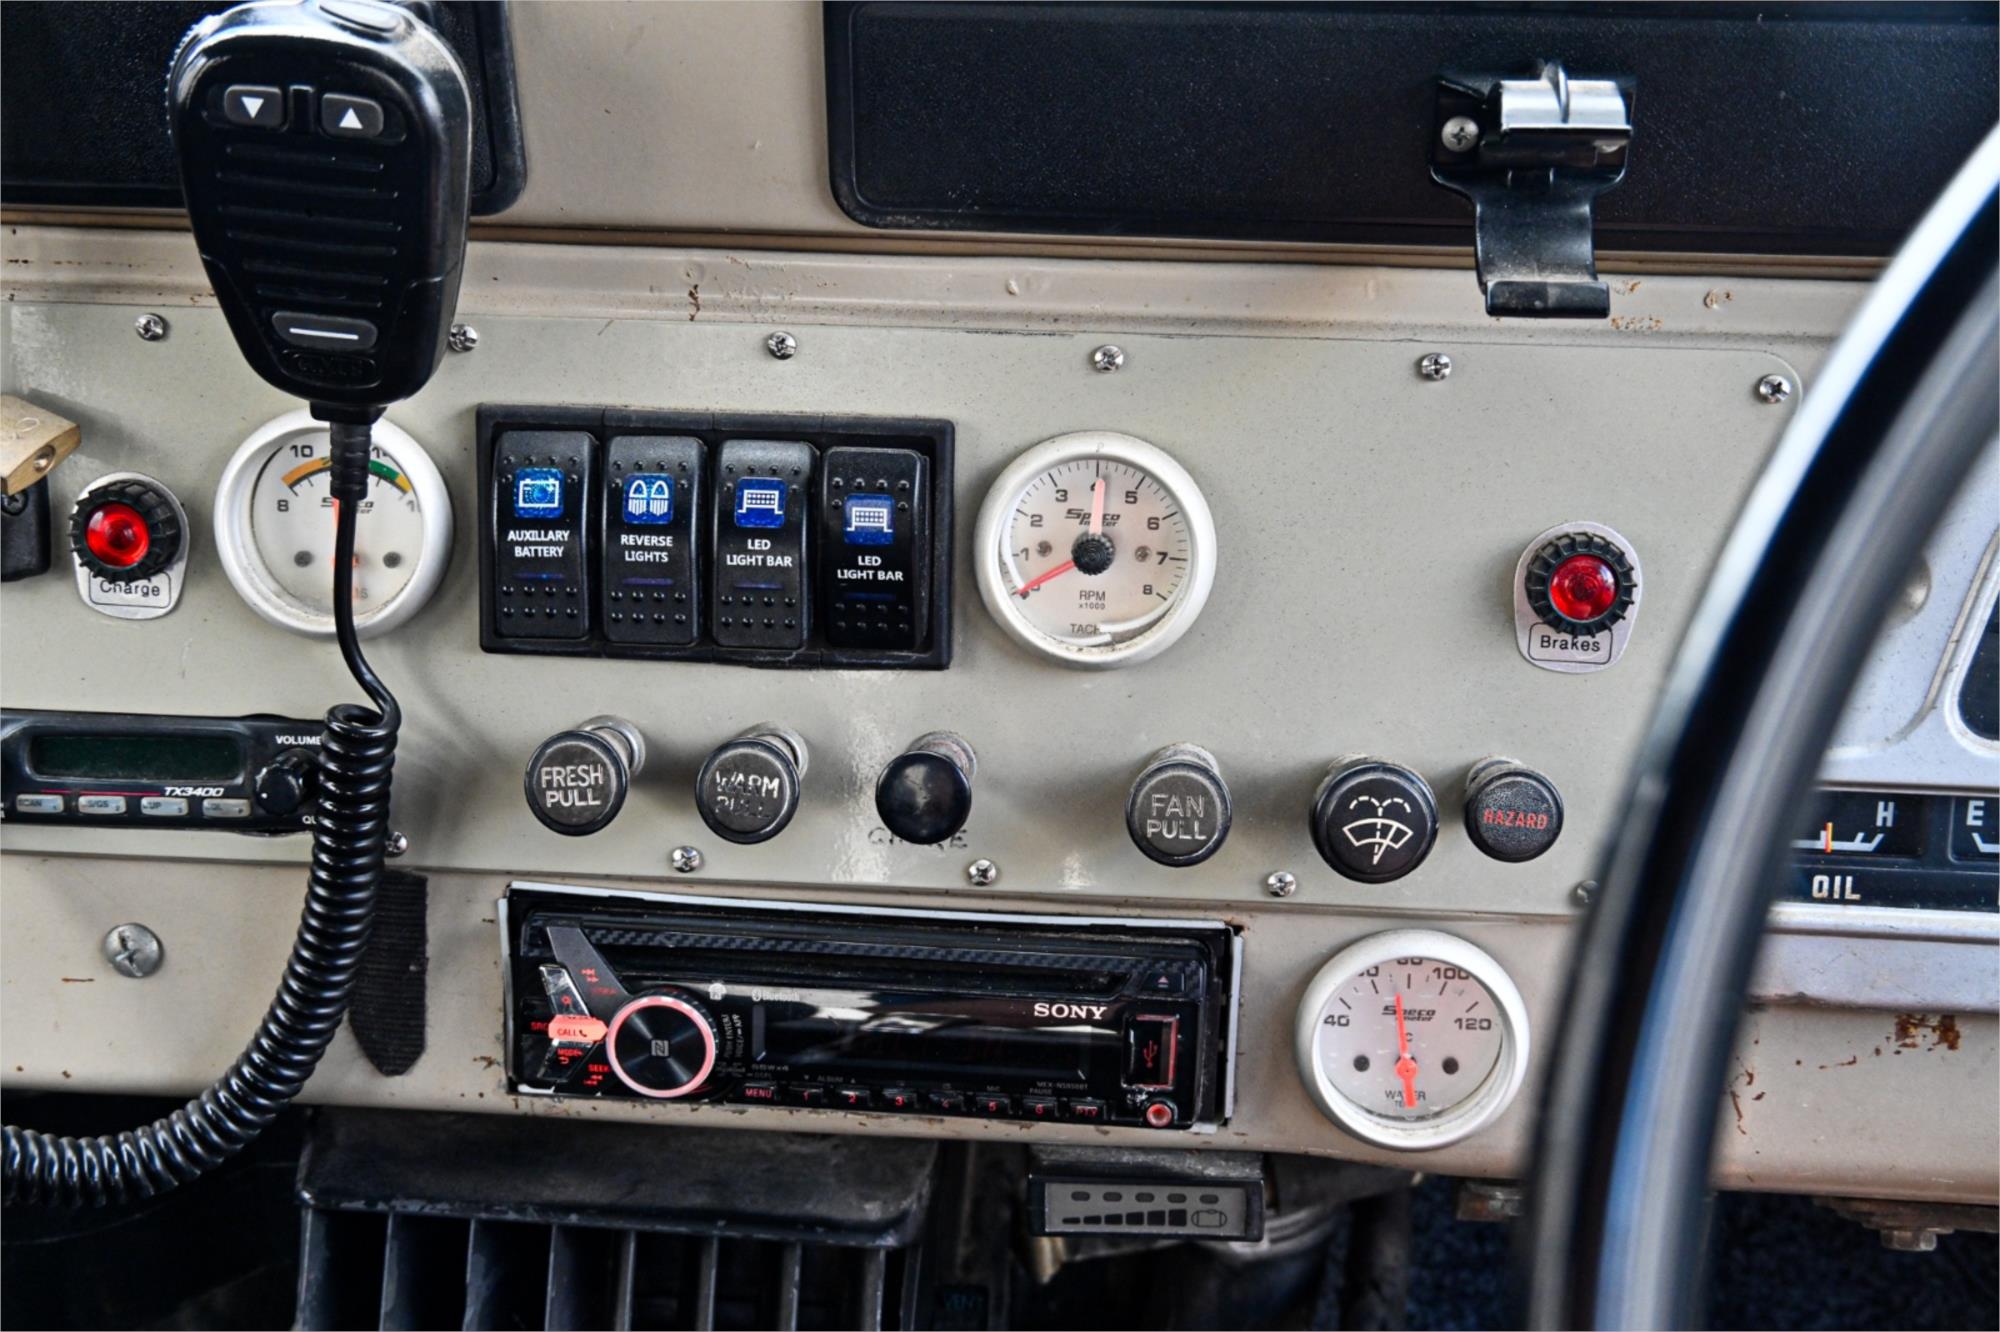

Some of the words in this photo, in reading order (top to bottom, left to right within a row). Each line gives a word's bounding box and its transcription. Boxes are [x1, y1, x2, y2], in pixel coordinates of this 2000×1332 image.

[290, 445, 314, 458] 10
[1055, 489, 1068, 503] 3
[1125, 490, 1138, 504] 5
[277, 499, 290, 512] 8
[1030, 514, 1043, 527] 2
[1064, 508, 1121, 525] Spco
[1147, 517, 1160, 530] 6
[507, 530, 570, 542] AUXILLARY
[620, 535, 673, 547] REVERSE
[747, 539, 771, 550] LED
[514, 546, 564, 557] BATTERY
[625, 551, 669, 562] LIGHTS
[1157, 551, 1169, 565] 7
[726, 555, 764, 566] LIGHT
[766, 555, 793, 567] BAR
[857, 555, 882, 566] LED
[837, 569, 875, 580] LIGHT
[877, 570, 904, 581] BAR
[1079, 590, 1106, 601] RPM
[1142, 584, 1153, 595] 8
[1540, 634, 1601, 652] Brakes
[275, 735, 322, 745] VOLUME
[541, 763, 603, 788] FRESH
[164, 786, 225, 797] TX3400
[546, 787, 601, 808] PULL
[1151, 794, 1205, 819] FAN
[1483, 808, 1549, 830] HAZARD
[1875, 801, 1895, 827] H
[1965, 800, 1985, 827] E
[1146, 819, 1207, 841] PULL
[1811, 874, 1862, 901] OIL
[1432, 967, 1470, 980] 100
[1033, 1002, 1108, 1020] SONY
[1323, 1014, 1350, 1027] 40
[1454, 1017, 1492, 1031] 120
[557, 1028, 577, 1037] CALL
[744, 1087, 773, 1098] MENU
[849, 1092, 857, 1104] 2
[895, 1095, 904, 1106] 3
[987, 1101, 997, 1112] 5
[1034, 1103, 1044, 1114] 6
